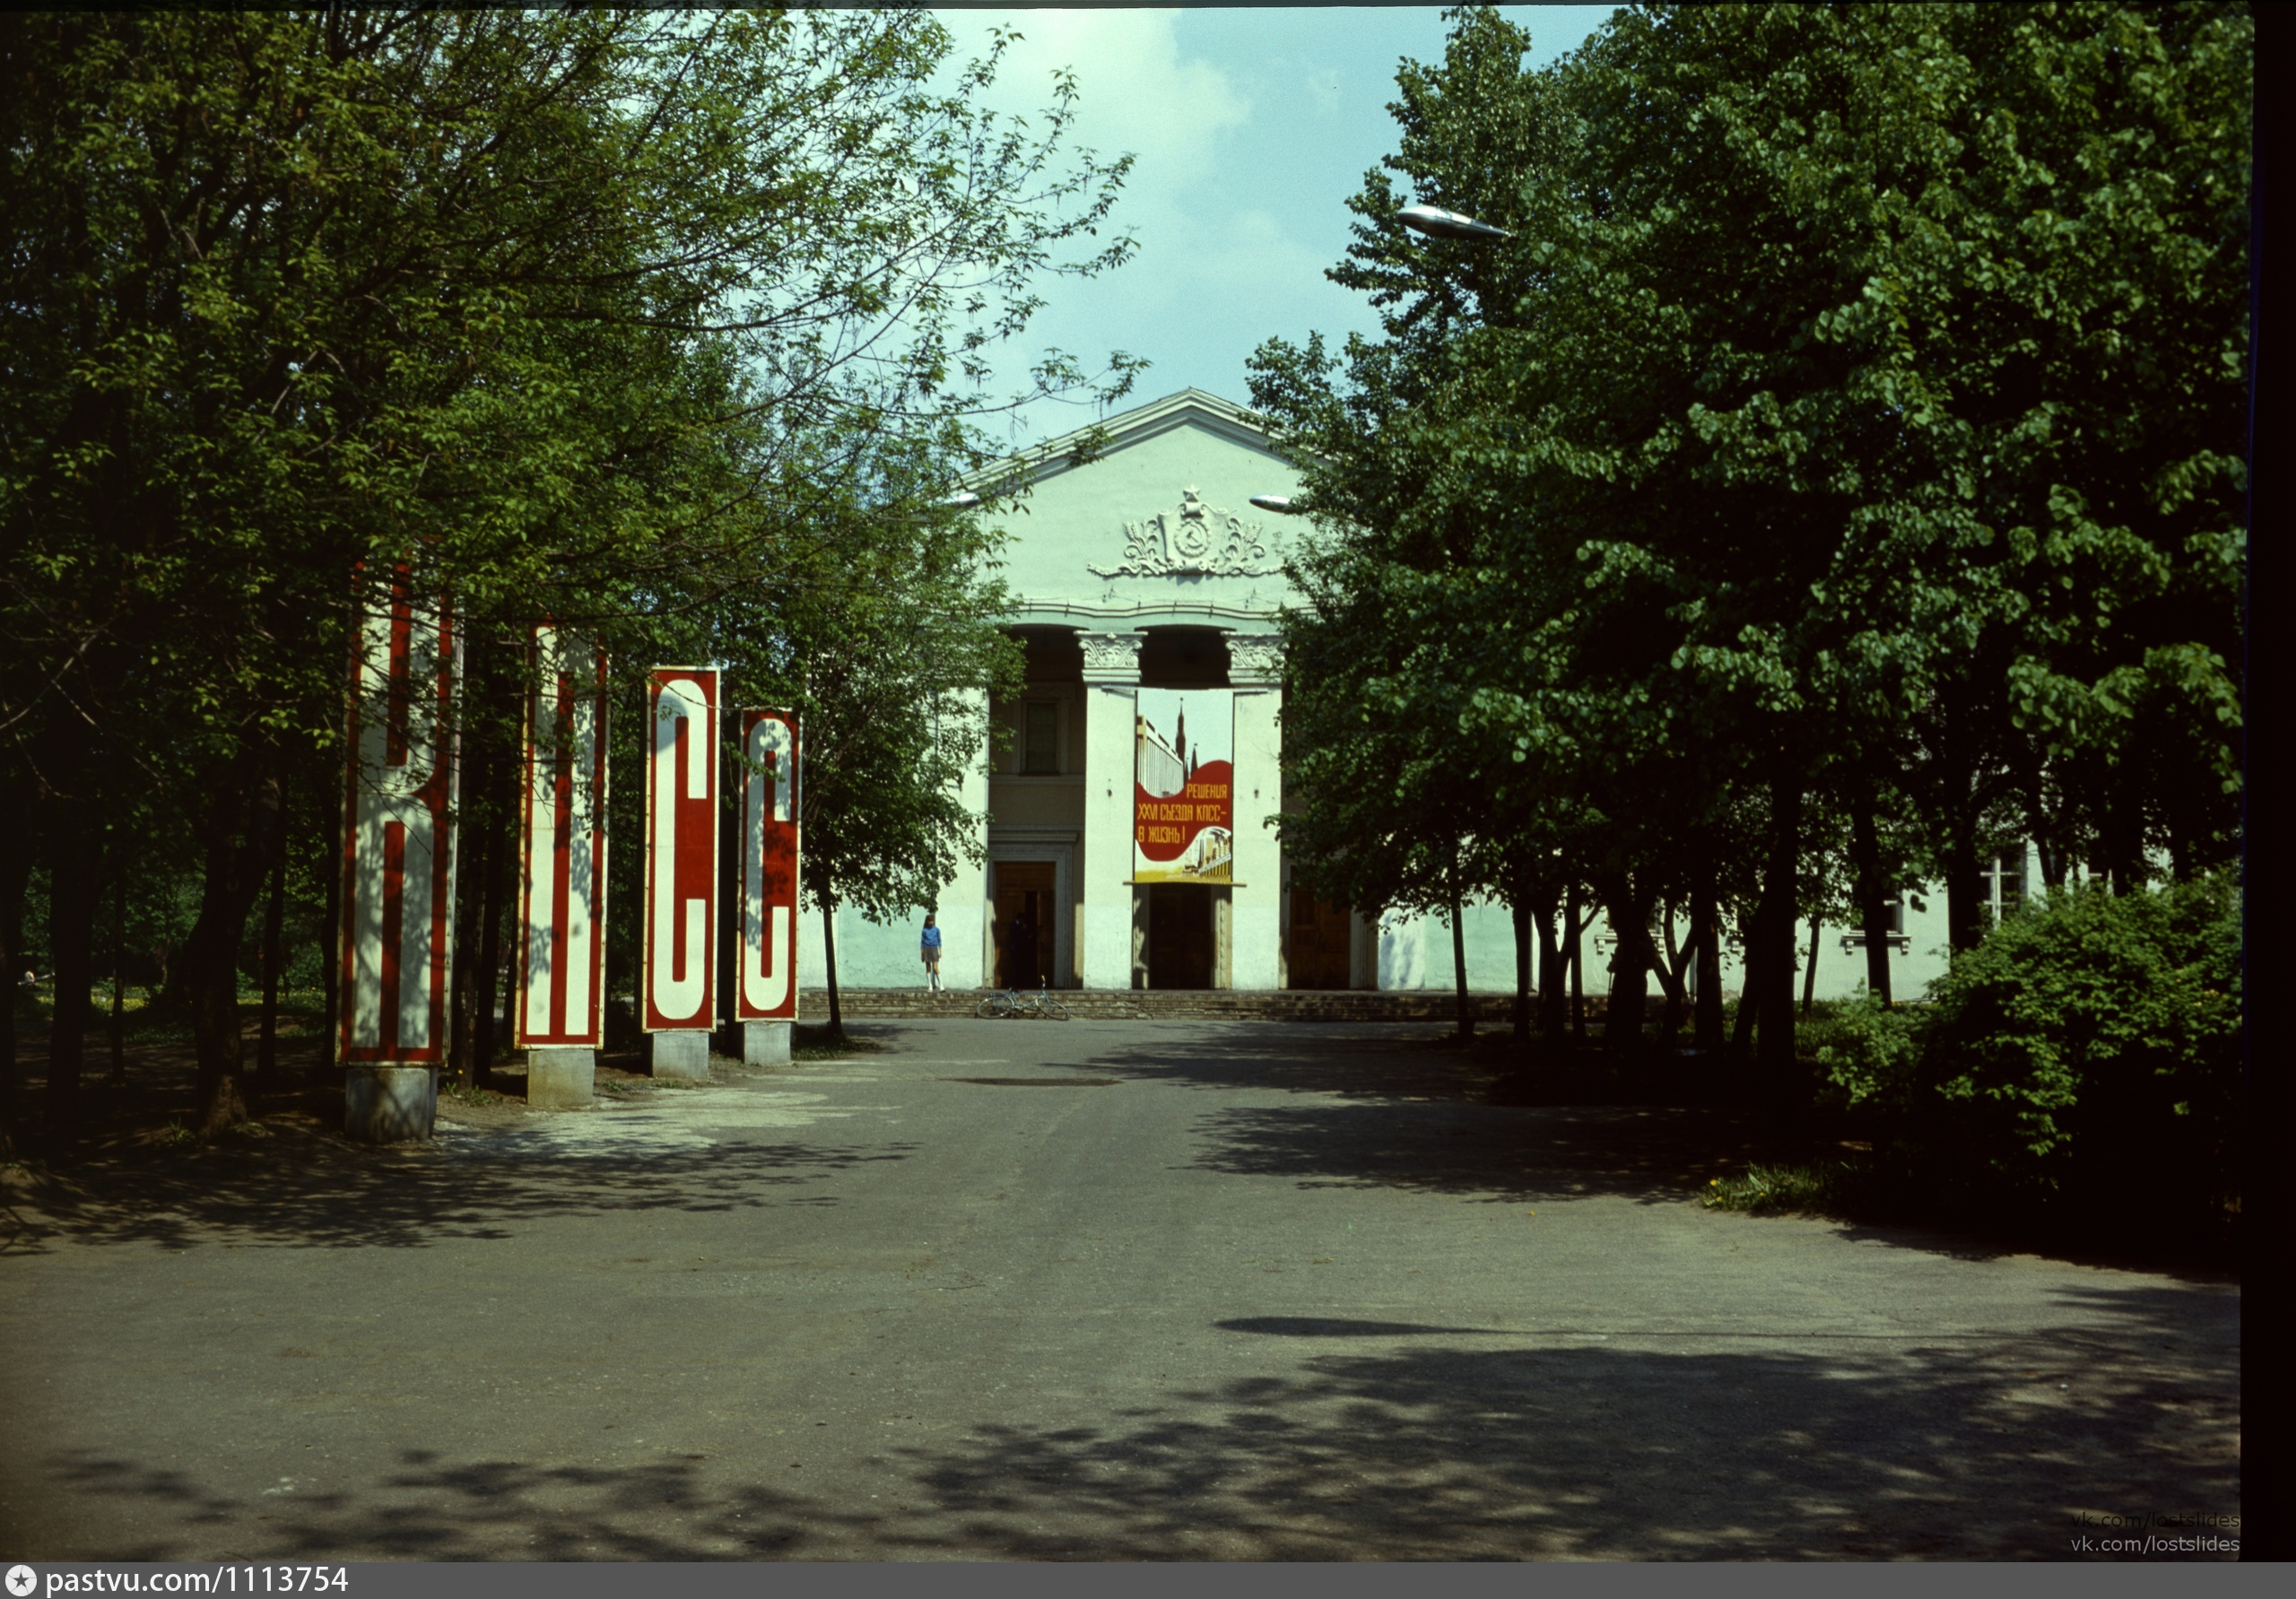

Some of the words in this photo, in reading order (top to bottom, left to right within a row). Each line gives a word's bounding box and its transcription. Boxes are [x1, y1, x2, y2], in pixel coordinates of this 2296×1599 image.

[1187, 783, 1227, 799] РЕШЕНИЯ
[1137, 803, 1158, 821] XXVI
[1160, 803, 1194, 821] СЪЕЗДА
[1137, 825, 1145, 843] В
